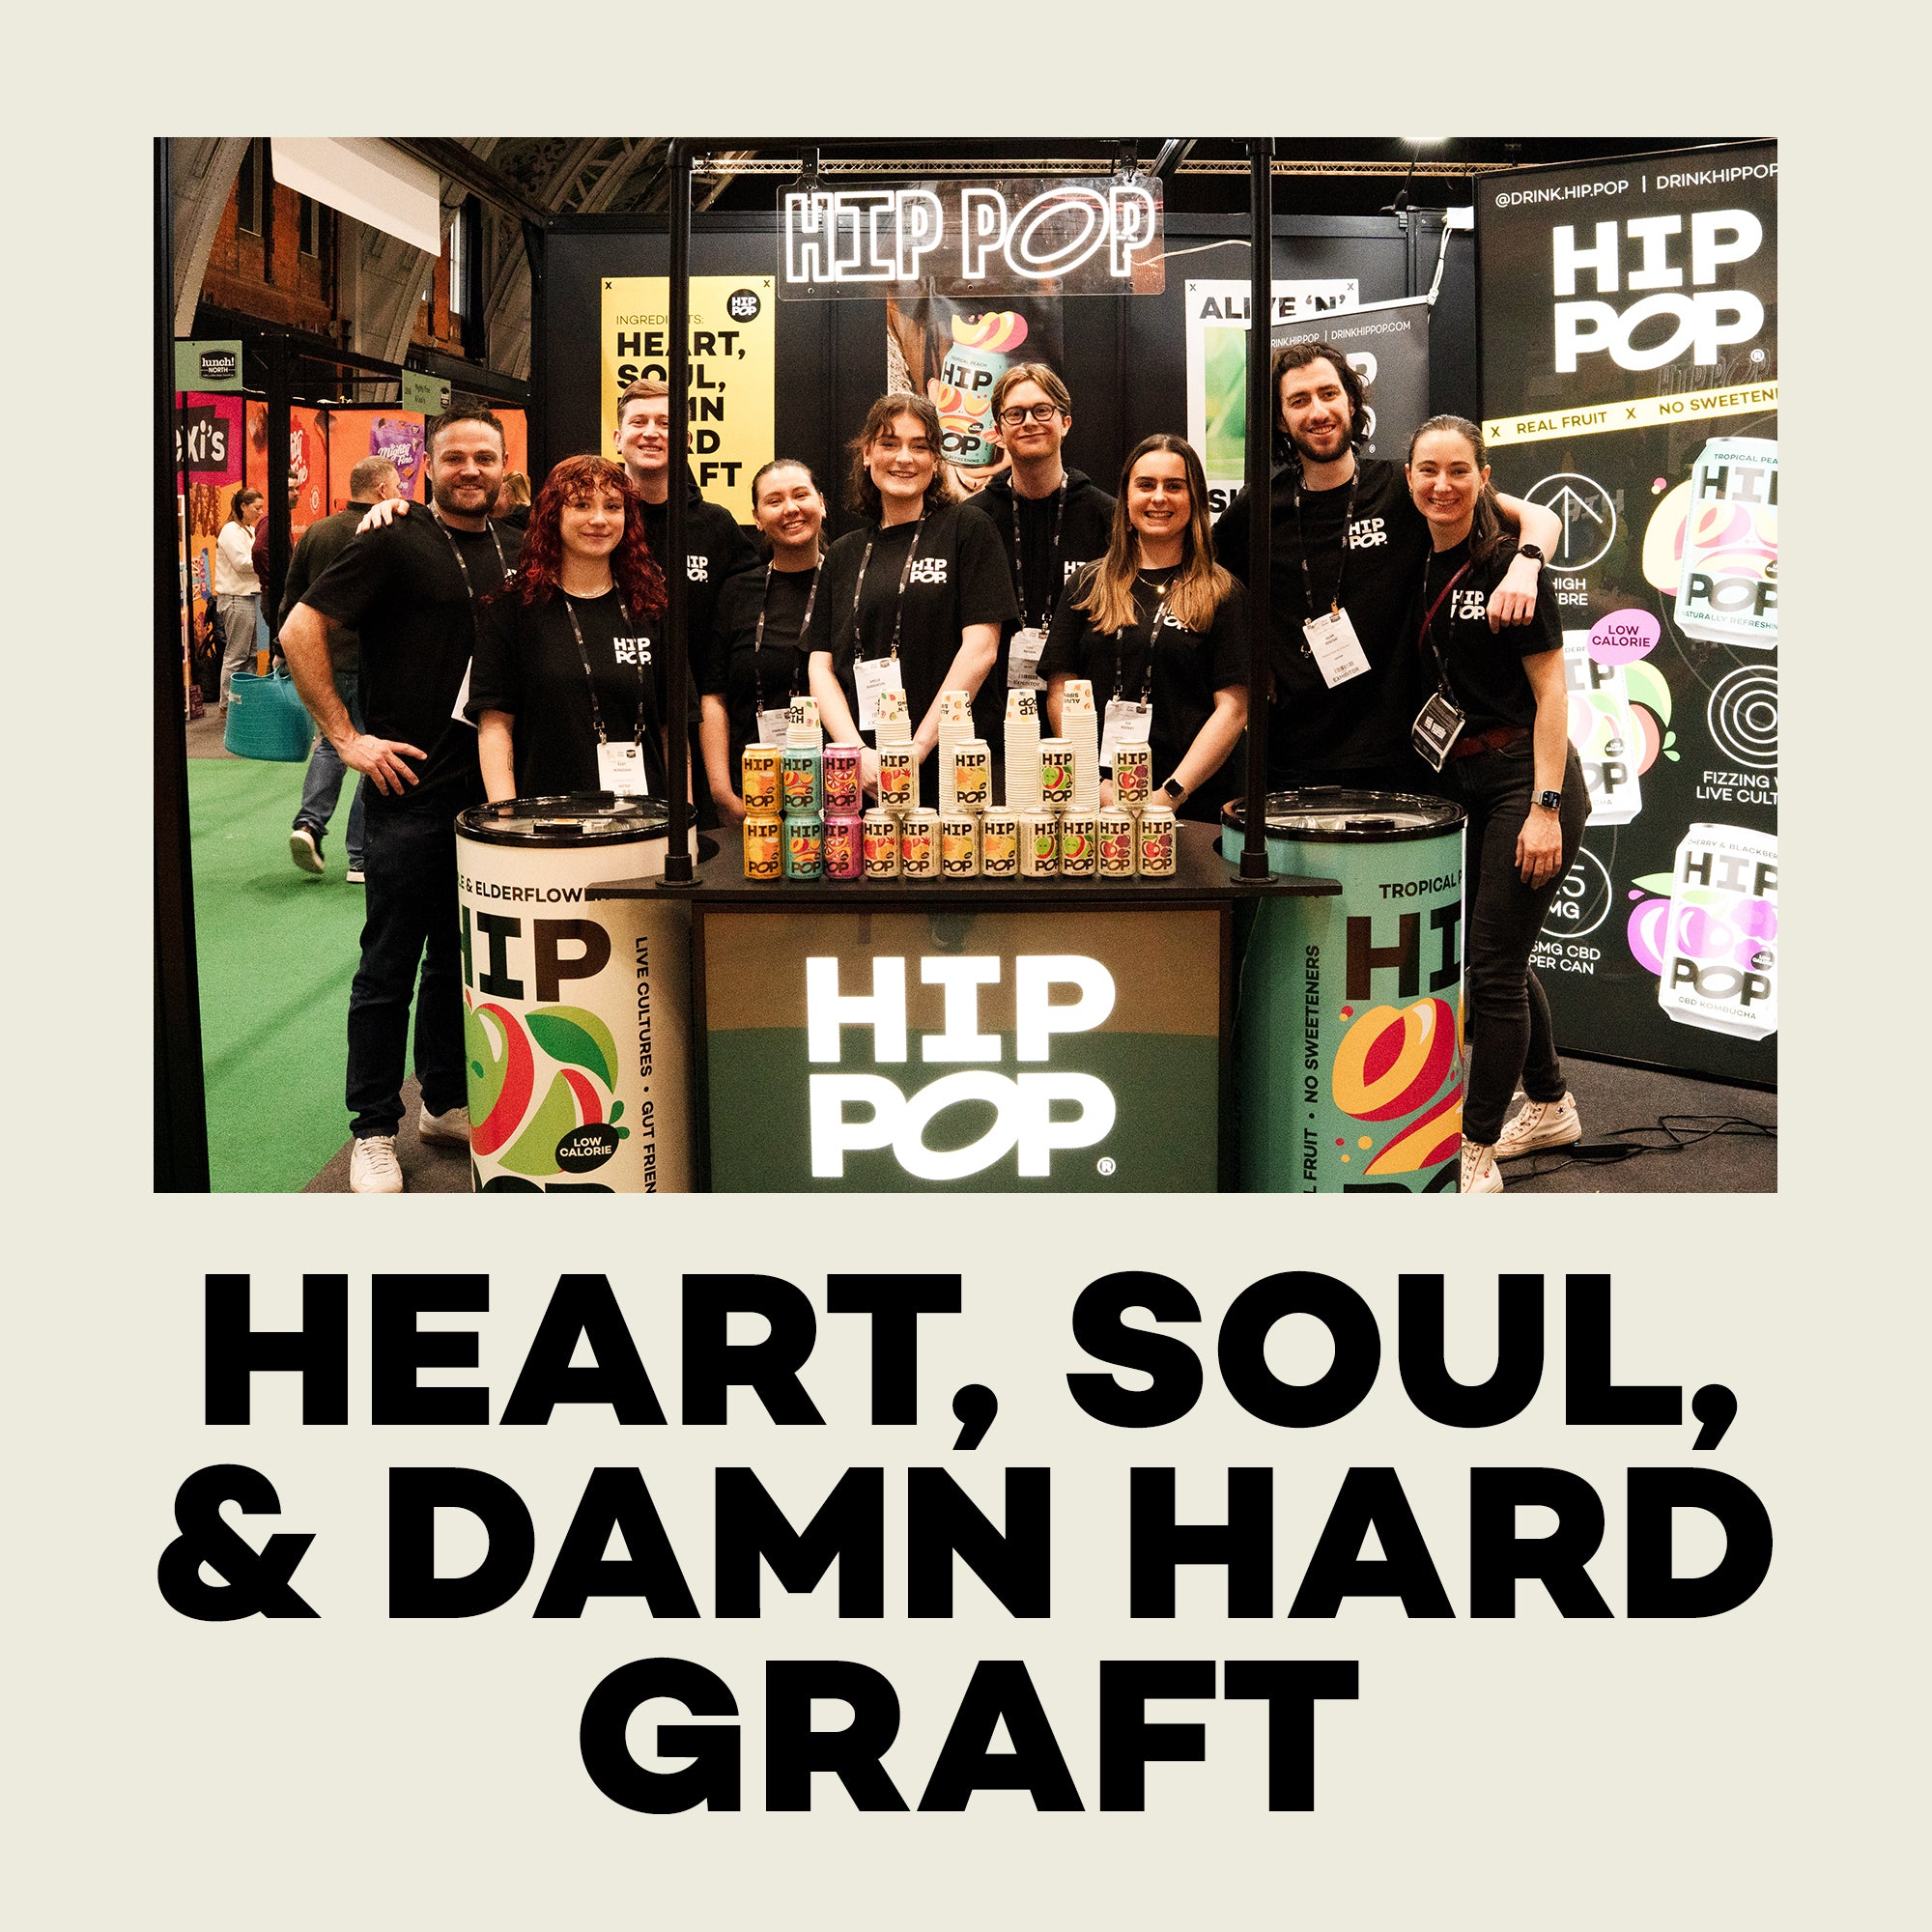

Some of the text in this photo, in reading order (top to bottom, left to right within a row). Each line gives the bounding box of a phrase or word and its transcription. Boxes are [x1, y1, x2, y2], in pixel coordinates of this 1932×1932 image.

[1495, 181, 1629, 208] @DRINK.HIP.POP
[785, 186, 1156, 282] HIP POP
[1553, 209, 1763, 297] HIP
[731, 297, 757, 306] HIP
[1200, 297, 1296, 320] ALIE
[731, 305, 757, 316] POP
[616, 314, 704, 325] INGREDITS:
[1331, 321, 1411, 340] DRINKHIPPOP.COM
[617, 331, 746, 360] HERT,
[201, 356, 235, 367] lunch!
[617, 363, 726, 392] SOL,
[942, 361, 993, 391] HIP
[1517, 416, 1557, 435] REAL
[1562, 412, 1607, 429] FRUIT
[1659, 401, 1684, 415] NO
[1690, 387, 1777, 411] SWEETEN
[942, 432, 980, 455] OP
[1714, 453, 1758, 463] TROPICAL
[1349, 518, 1385, 536] HIP
[911, 557, 947, 571] HIP
[1608, 625, 1639, 636] LOW
[613, 637, 651, 651] HIP
[1592, 636, 1651, 647] CALORIE
[1565, 658, 1615, 691] IP
[744, 757, 774, 771] HIP
[783, 758, 813, 771] HIP
[826, 757, 856, 770] HIP
[880, 754, 909, 767] HIP
[955, 753, 986, 767] HIP
[1042, 753, 1072, 765] HIP
[1117, 753, 1148, 765] HIP
[1703, 770, 1770, 788] FIZZING
[826, 794, 856, 807] POP
[881, 791, 911, 804] POP
[956, 790, 986, 803] POP
[1042, 789, 1072, 803] POP
[1119, 789, 1149, 802] POP
[1696, 785, 1732, 802] LIVE
[745, 794, 775, 808] POP
[784, 795, 813, 808] POP
[748, 824, 778, 837] HIP
[790, 825, 820, 838] HIP
[865, 824, 894, 836] HIP
[943, 823, 973, 836] HIP
[984, 822, 1014, 835] HIP
[1064, 821, 1094, 835] HIP
[1100, 822, 1130, 835] HIP
[1142, 821, 1172, 834] HIP
[749, 861, 779, 873] POP
[791, 861, 821, 873] POP
[865, 860, 895, 872] POP
[943, 860, 973, 872] POP
[985, 859, 1015, 870] POP
[1064, 858, 1094, 871] POP
[1100, 858, 1130, 870] POP
[1142, 858, 1172, 870] POP
[1682, 850, 1777, 896] HIP
[475, 880, 609, 903] ELDERFLOW
[1379, 874, 1457, 899] TROPICAL
[635, 936, 649, 979] LIVE
[1567, 945, 1601, 960] CBD
[1528, 954, 1594, 975] PER CAN
[1669, 956, 1772, 1007] POP
[806, 954, 1116, 1063] HIP
[1305, 945, 1321, 1070] SWEETENERS
[1678, 996, 1756, 1020] CBD KOMBUCHA
[637, 982, 652, 1078] CULTURES
[1304, 1075, 1319, 1103] NO
[641, 1100, 655, 1138] GUT
[573, 1137, 602, 1148] LOW
[559, 1145, 612, 1157] CALORIE
[1303, 1127, 1318, 1180] FRUIT
